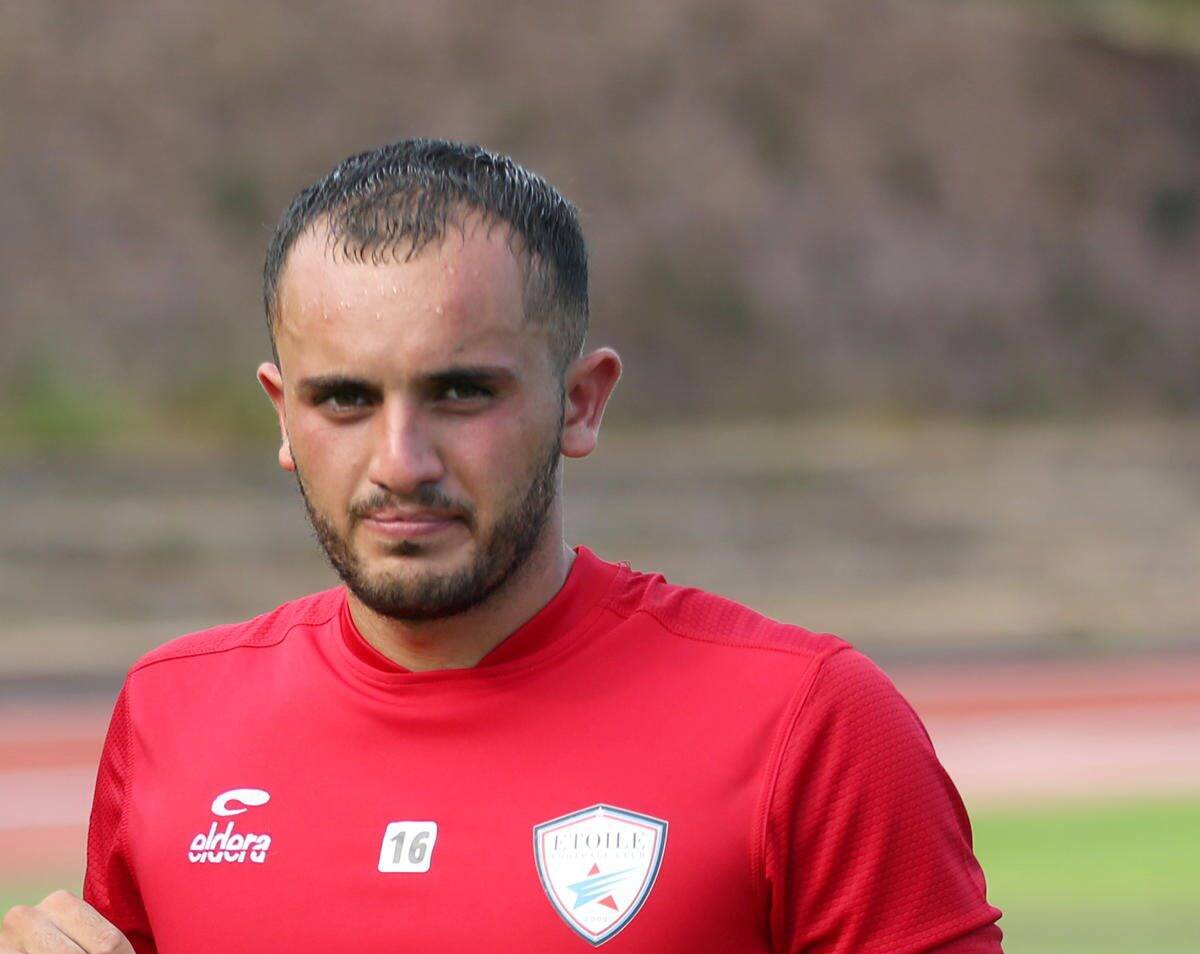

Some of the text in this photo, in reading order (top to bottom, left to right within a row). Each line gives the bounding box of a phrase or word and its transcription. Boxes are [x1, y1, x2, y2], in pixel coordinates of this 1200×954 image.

[188, 821, 271, 863] eldera
[391, 831, 430, 864] 16
[553, 832, 647, 850] ETOILE
